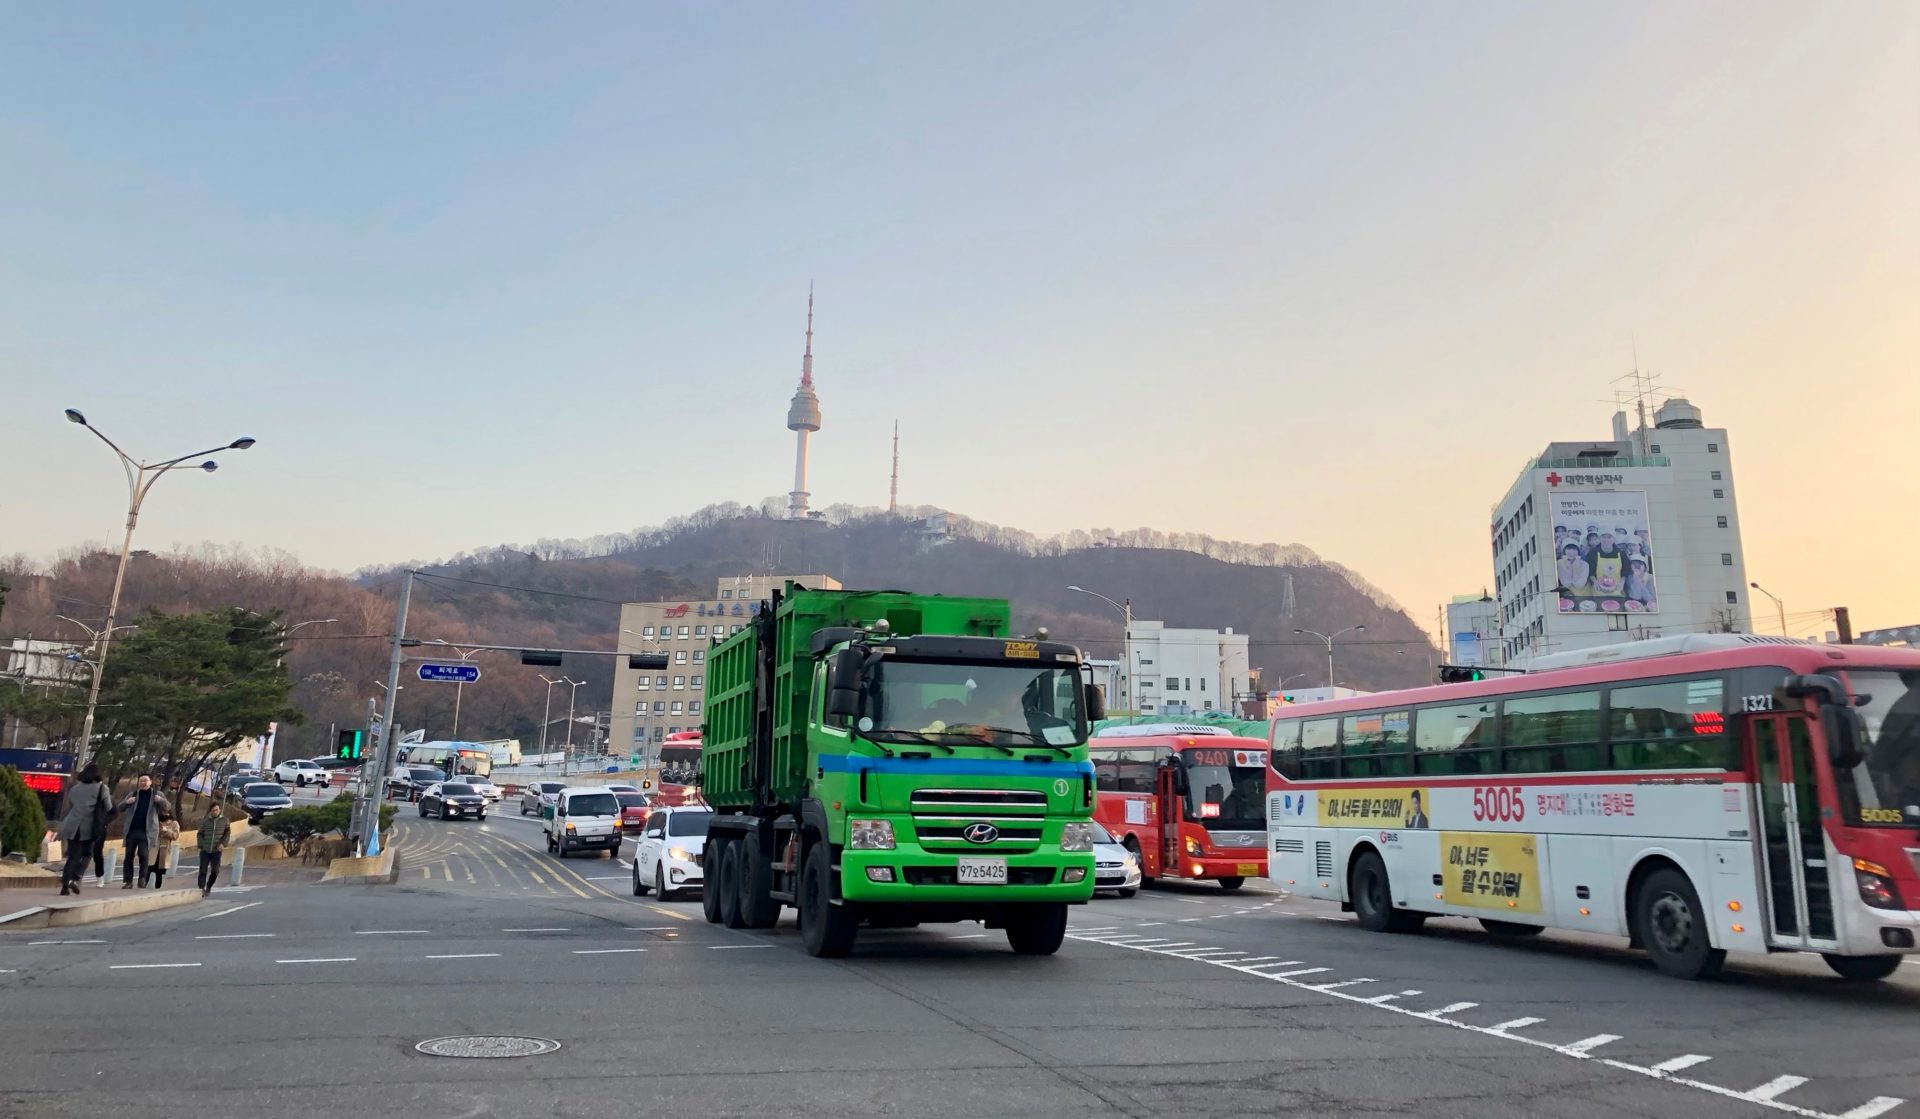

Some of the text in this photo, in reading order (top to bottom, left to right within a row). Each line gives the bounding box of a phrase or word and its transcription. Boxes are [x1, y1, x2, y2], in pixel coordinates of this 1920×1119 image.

[1565, 474, 1623, 485] 대한적십자사
[1005, 642, 1038, 650] TOMY
[1742, 694, 1773, 711] 1321
[1194, 751, 1230, 766] 9401
[1473, 787, 1525, 822] 5005
[1602, 793, 1635, 816] 광화문
[1861, 808, 1903, 823] 5005
[960, 865, 1005, 878] 97오5425
